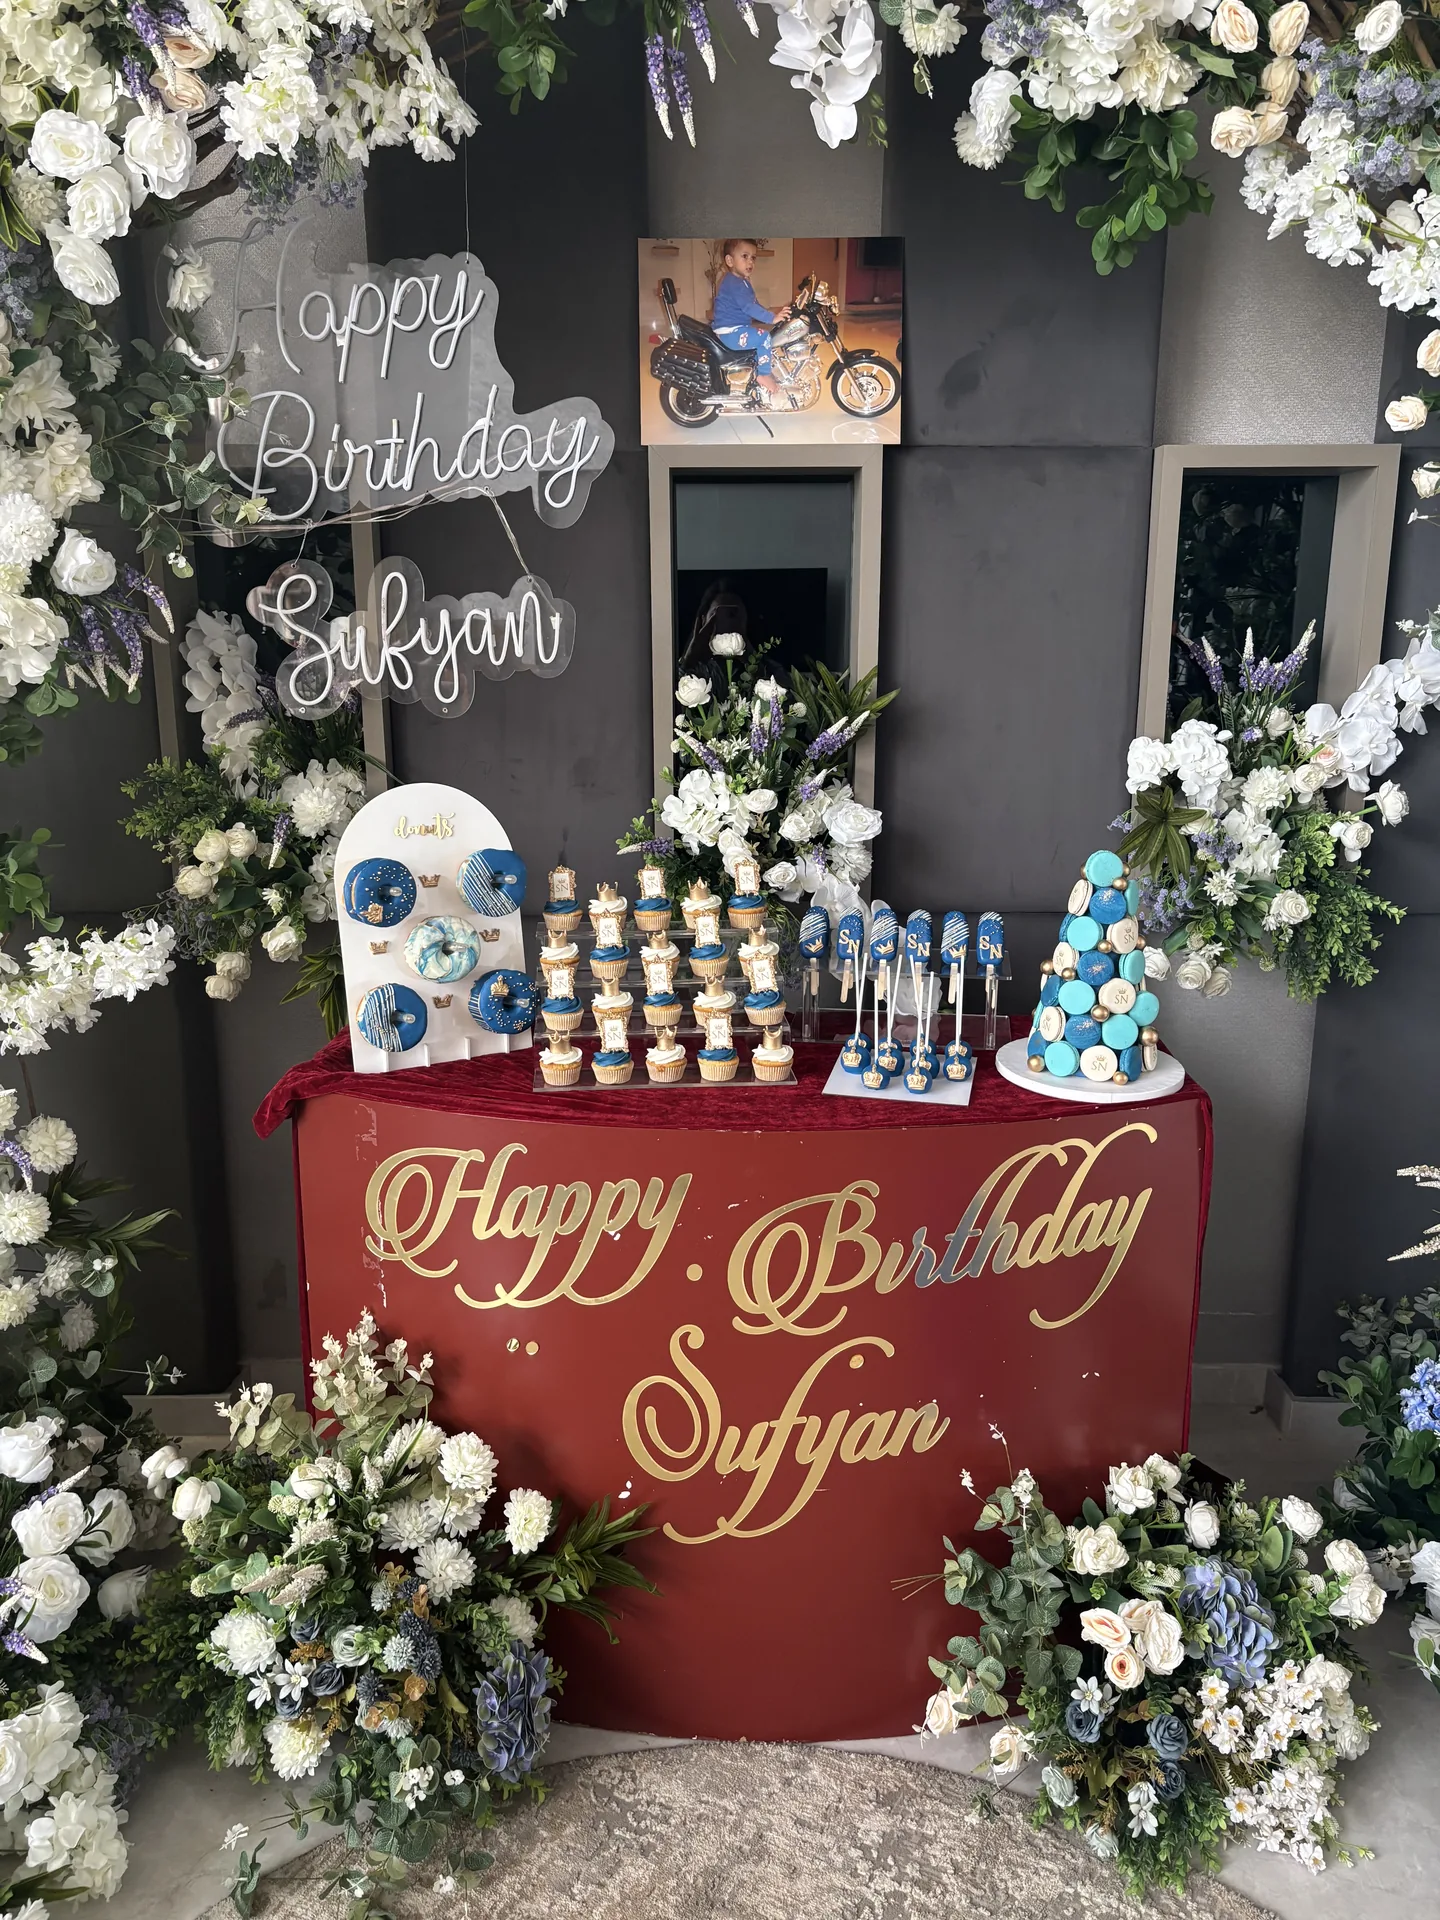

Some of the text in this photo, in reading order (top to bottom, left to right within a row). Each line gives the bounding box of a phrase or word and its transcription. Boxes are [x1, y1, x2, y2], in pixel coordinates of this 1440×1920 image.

[154, 217, 486, 384] Happy
[217, 384, 600, 521] Birthday
[258, 571, 560, 706] Sufyan
[556, 883, 569, 893] SN
[646, 881, 659, 890] SN
[602, 928, 615, 937] SN
[699, 926, 714, 937] SN
[839, 929, 860, 953] SN
[1124, 932, 1135, 944] SN
[907, 934, 930, 957] SN
[979, 935, 1003, 959] SN
[652, 974, 666, 985] SN
[758, 971, 771, 981] SN
[554, 979, 568, 990] SN
[1114, 994, 1128, 1005] SN
[608, 1031, 623, 1041] SN
[712, 1029, 727, 1039] SN
[1091, 1060, 1108, 1072] SN
[365, 1122, 1158, 1336] Happy Birthday
[622, 1324, 951, 1542] Sufyan
